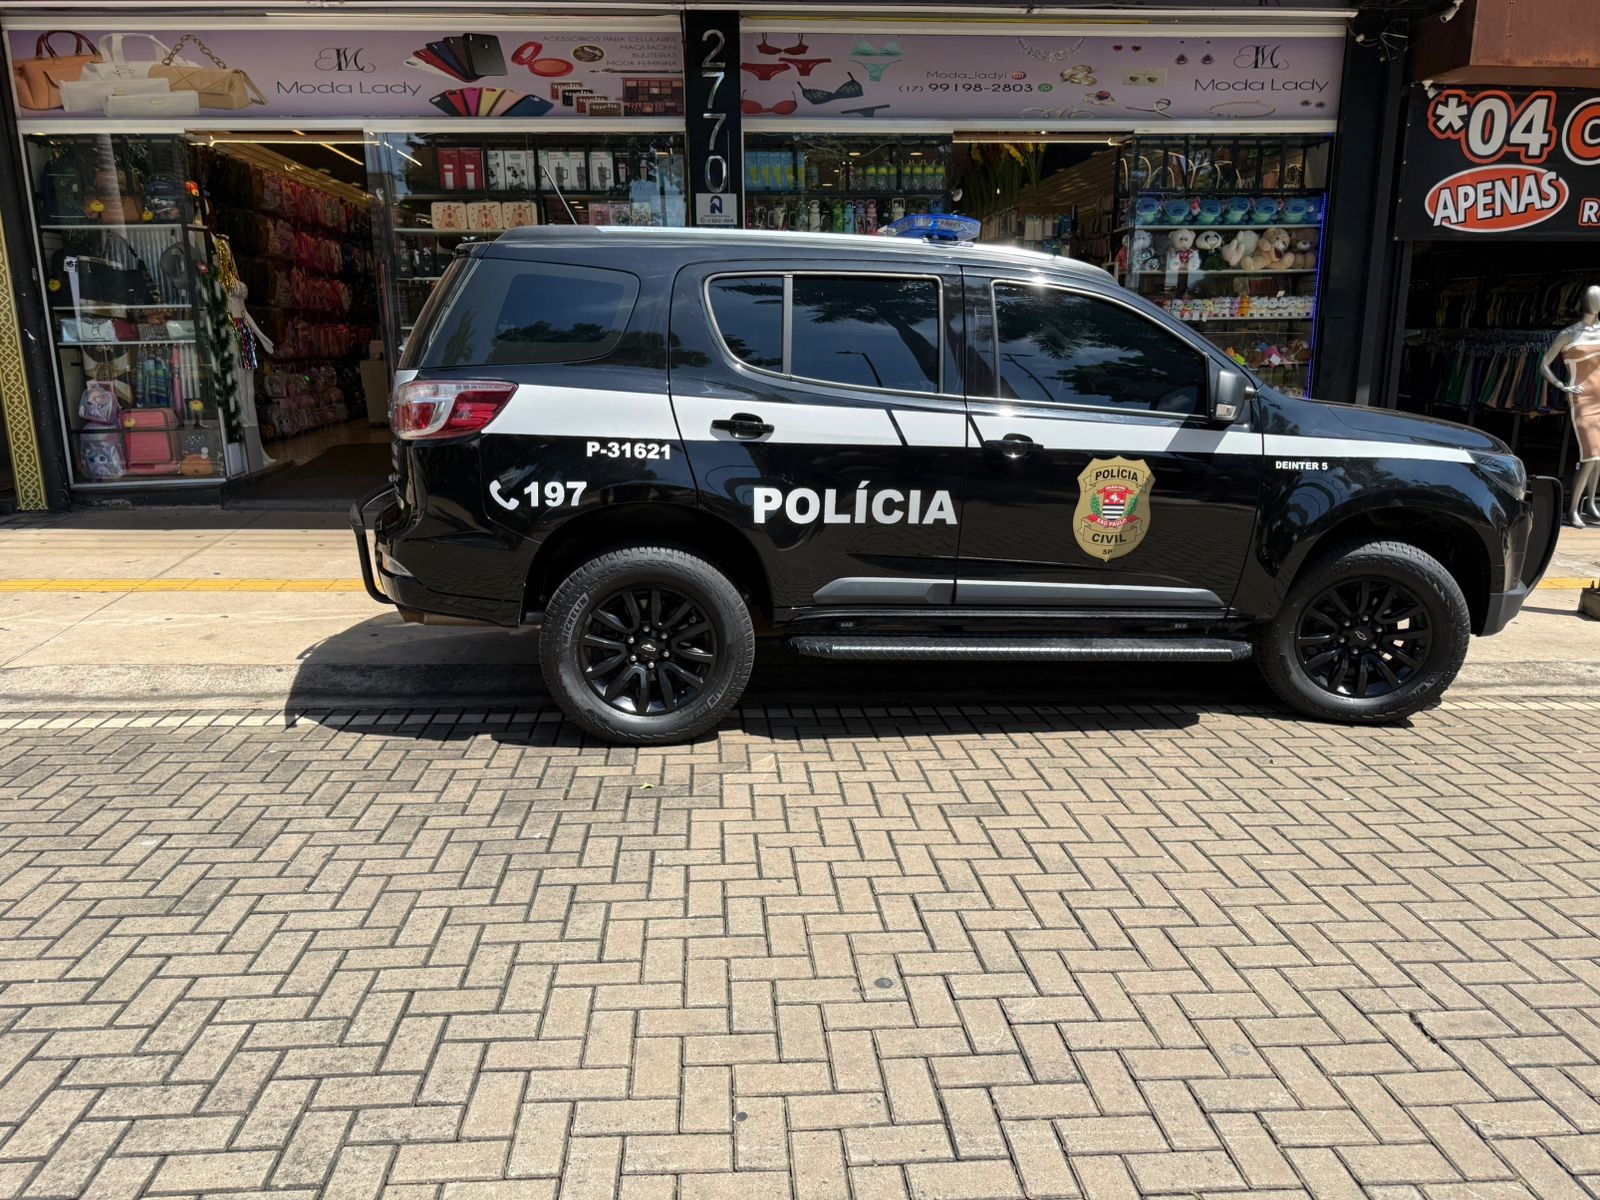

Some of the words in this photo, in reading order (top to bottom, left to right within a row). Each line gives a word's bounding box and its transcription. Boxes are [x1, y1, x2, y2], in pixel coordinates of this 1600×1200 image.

[276, 80, 353, 95] Moda
[358, 80, 422, 97] Lady
[897, 84, 924, 93] (17)
[927, 82, 1034, 93] 99198-2803
[1193, 78, 1265, 92] Moda
[1270, 78, 1330, 94] Lady
[701, 28, 729, 194] 2770
[1432, 170, 1558, 227] APENAS
[1581, 199, 1600, 224] R
[585, 440, 672, 460] P-31621
[1275, 460, 1320, 471] DEINTER
[1321, 461, 1329, 471] 5
[522, 480, 588, 508] 197
[752, 479, 959, 526] POLÍCIA
[1091, 532, 1128, 544] CIVIL
[1102, 548, 1114, 556] SP
